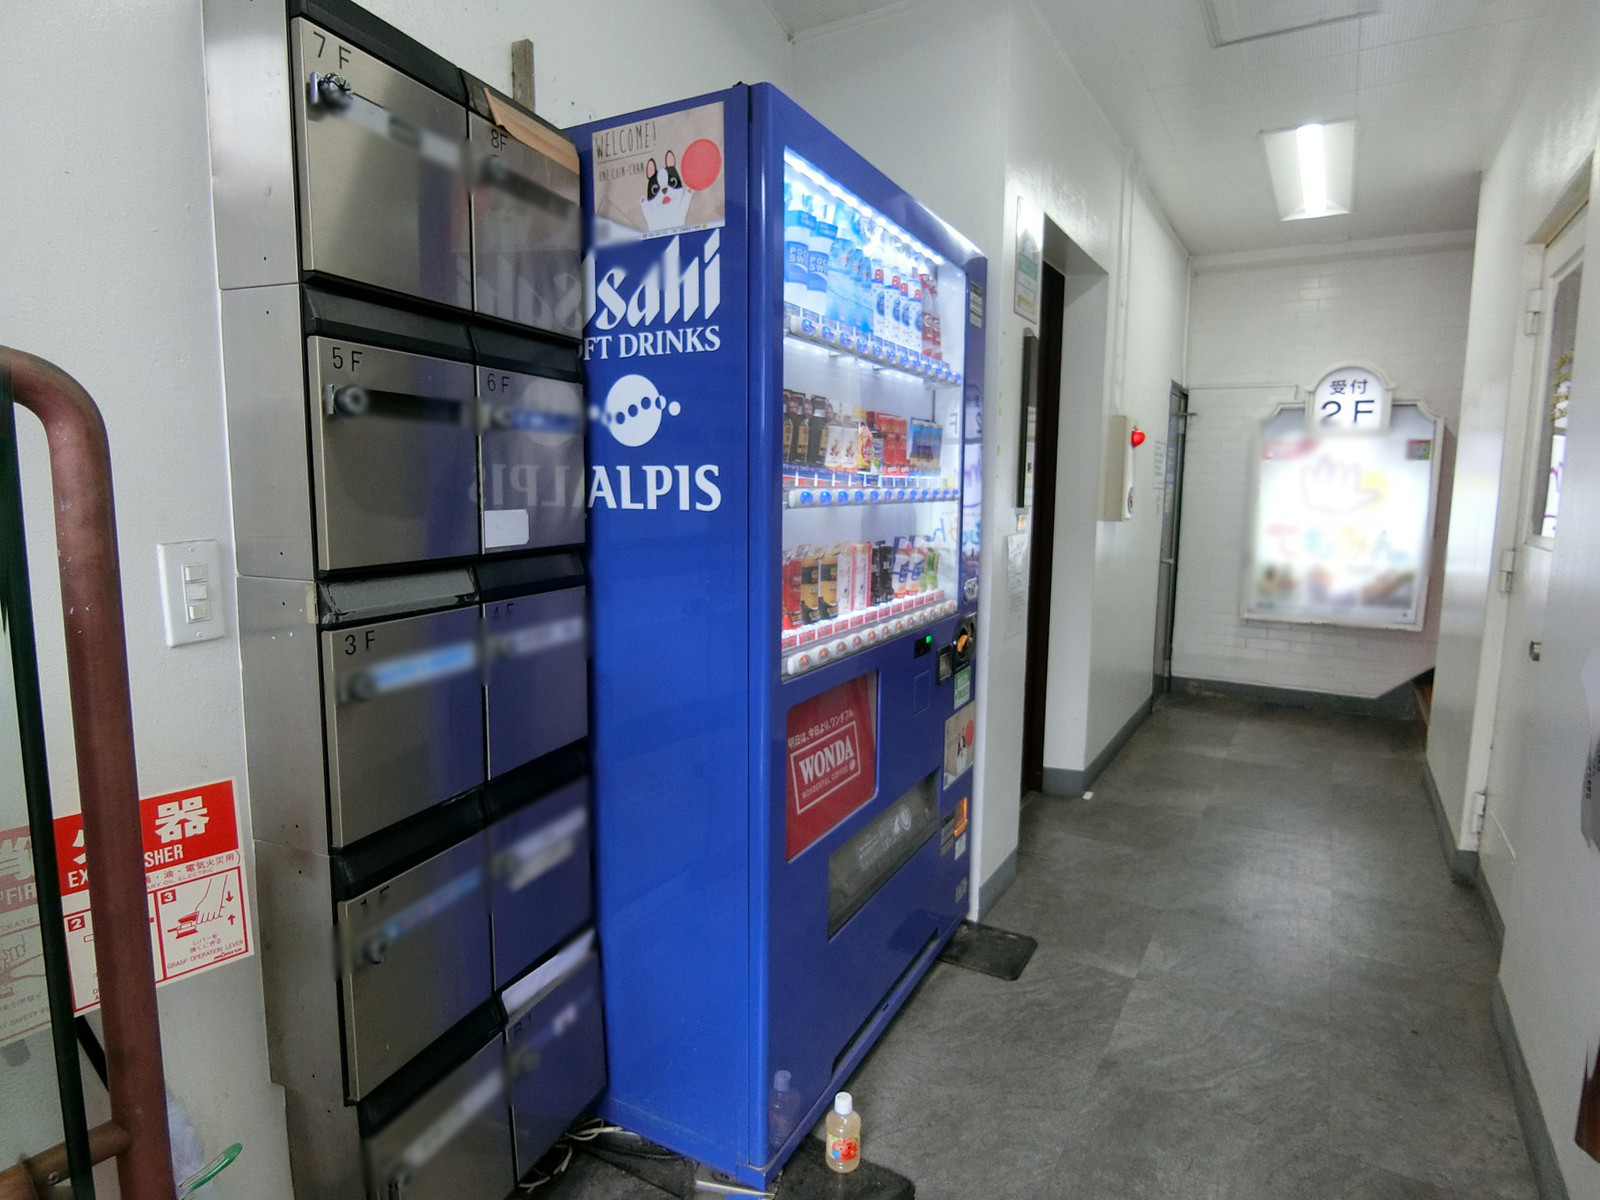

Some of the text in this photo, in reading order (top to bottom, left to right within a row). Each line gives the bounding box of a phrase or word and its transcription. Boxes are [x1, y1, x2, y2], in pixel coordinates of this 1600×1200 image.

[595, 122, 656, 159] WELCOME!
[619, 325, 721, 358] DRINKS
[1330, 379, 1368, 395] 受付
[799, 735, 855, 785] WONDA
[163, 891, 174, 903] 3
[71, 918, 83, 930] 2
[190, 947, 223, 962] OPERATION
